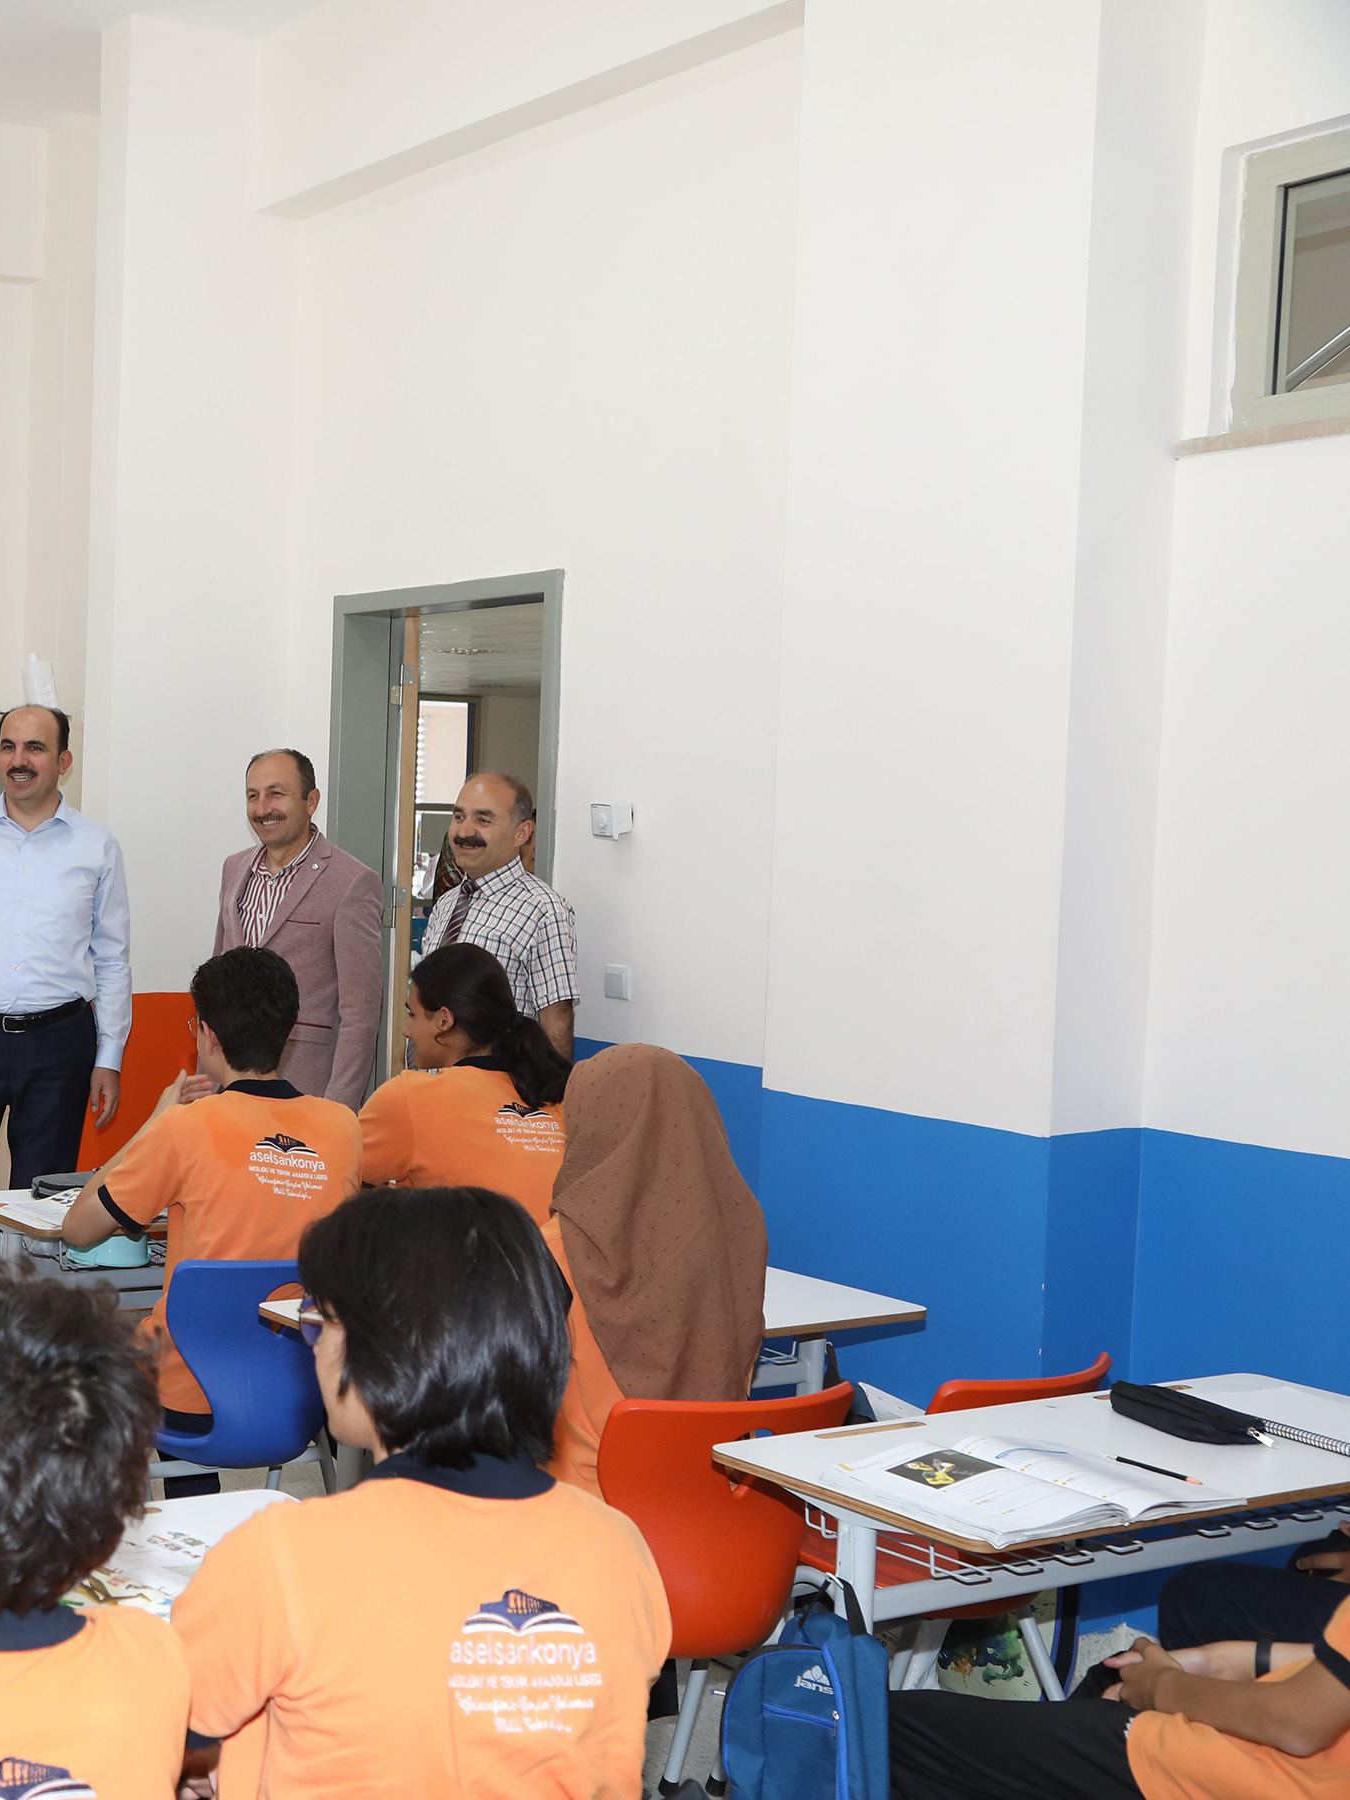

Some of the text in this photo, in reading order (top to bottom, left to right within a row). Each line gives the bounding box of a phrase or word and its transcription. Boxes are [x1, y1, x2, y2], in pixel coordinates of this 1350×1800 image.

[494, 1116, 560, 1131] aselsankonya
[250, 1151, 325, 1172] aselsankonya
[450, 1635, 597, 1670] aselsankonya
[486, 1675, 498, 1689] VE
[793, 1675, 834, 1695] jans
